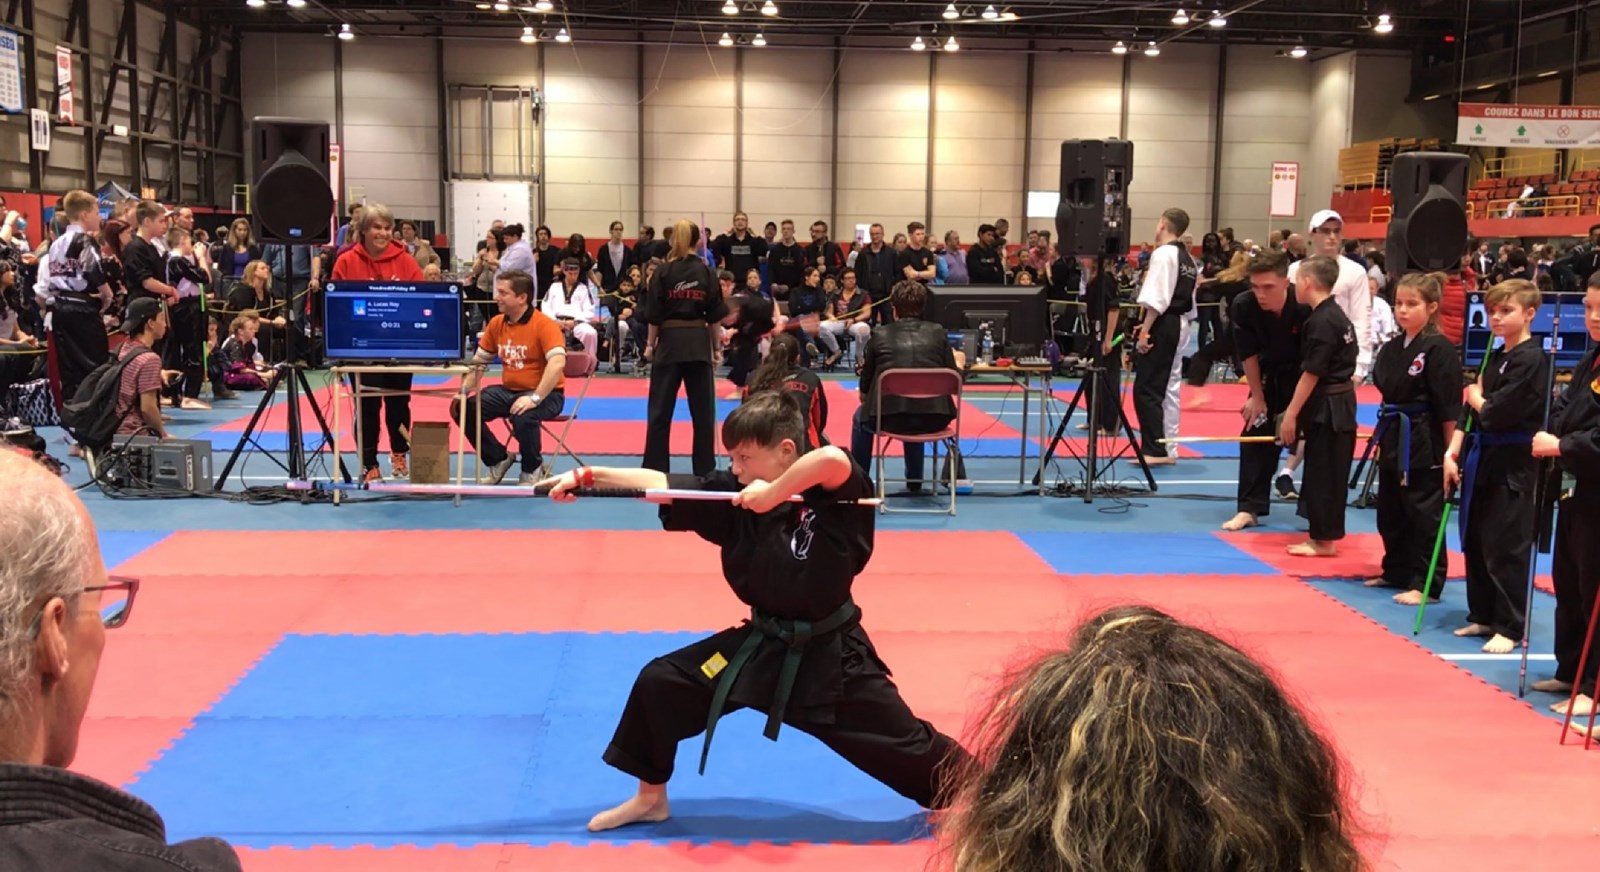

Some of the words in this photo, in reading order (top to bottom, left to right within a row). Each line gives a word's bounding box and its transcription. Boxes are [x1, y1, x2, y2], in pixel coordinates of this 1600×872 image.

[1484, 107, 1519, 117] COUREZ
[1521, 108, 1545, 118] DANS
[1548, 109, 1558, 118] LE
[1561, 109, 1579, 118] BON
